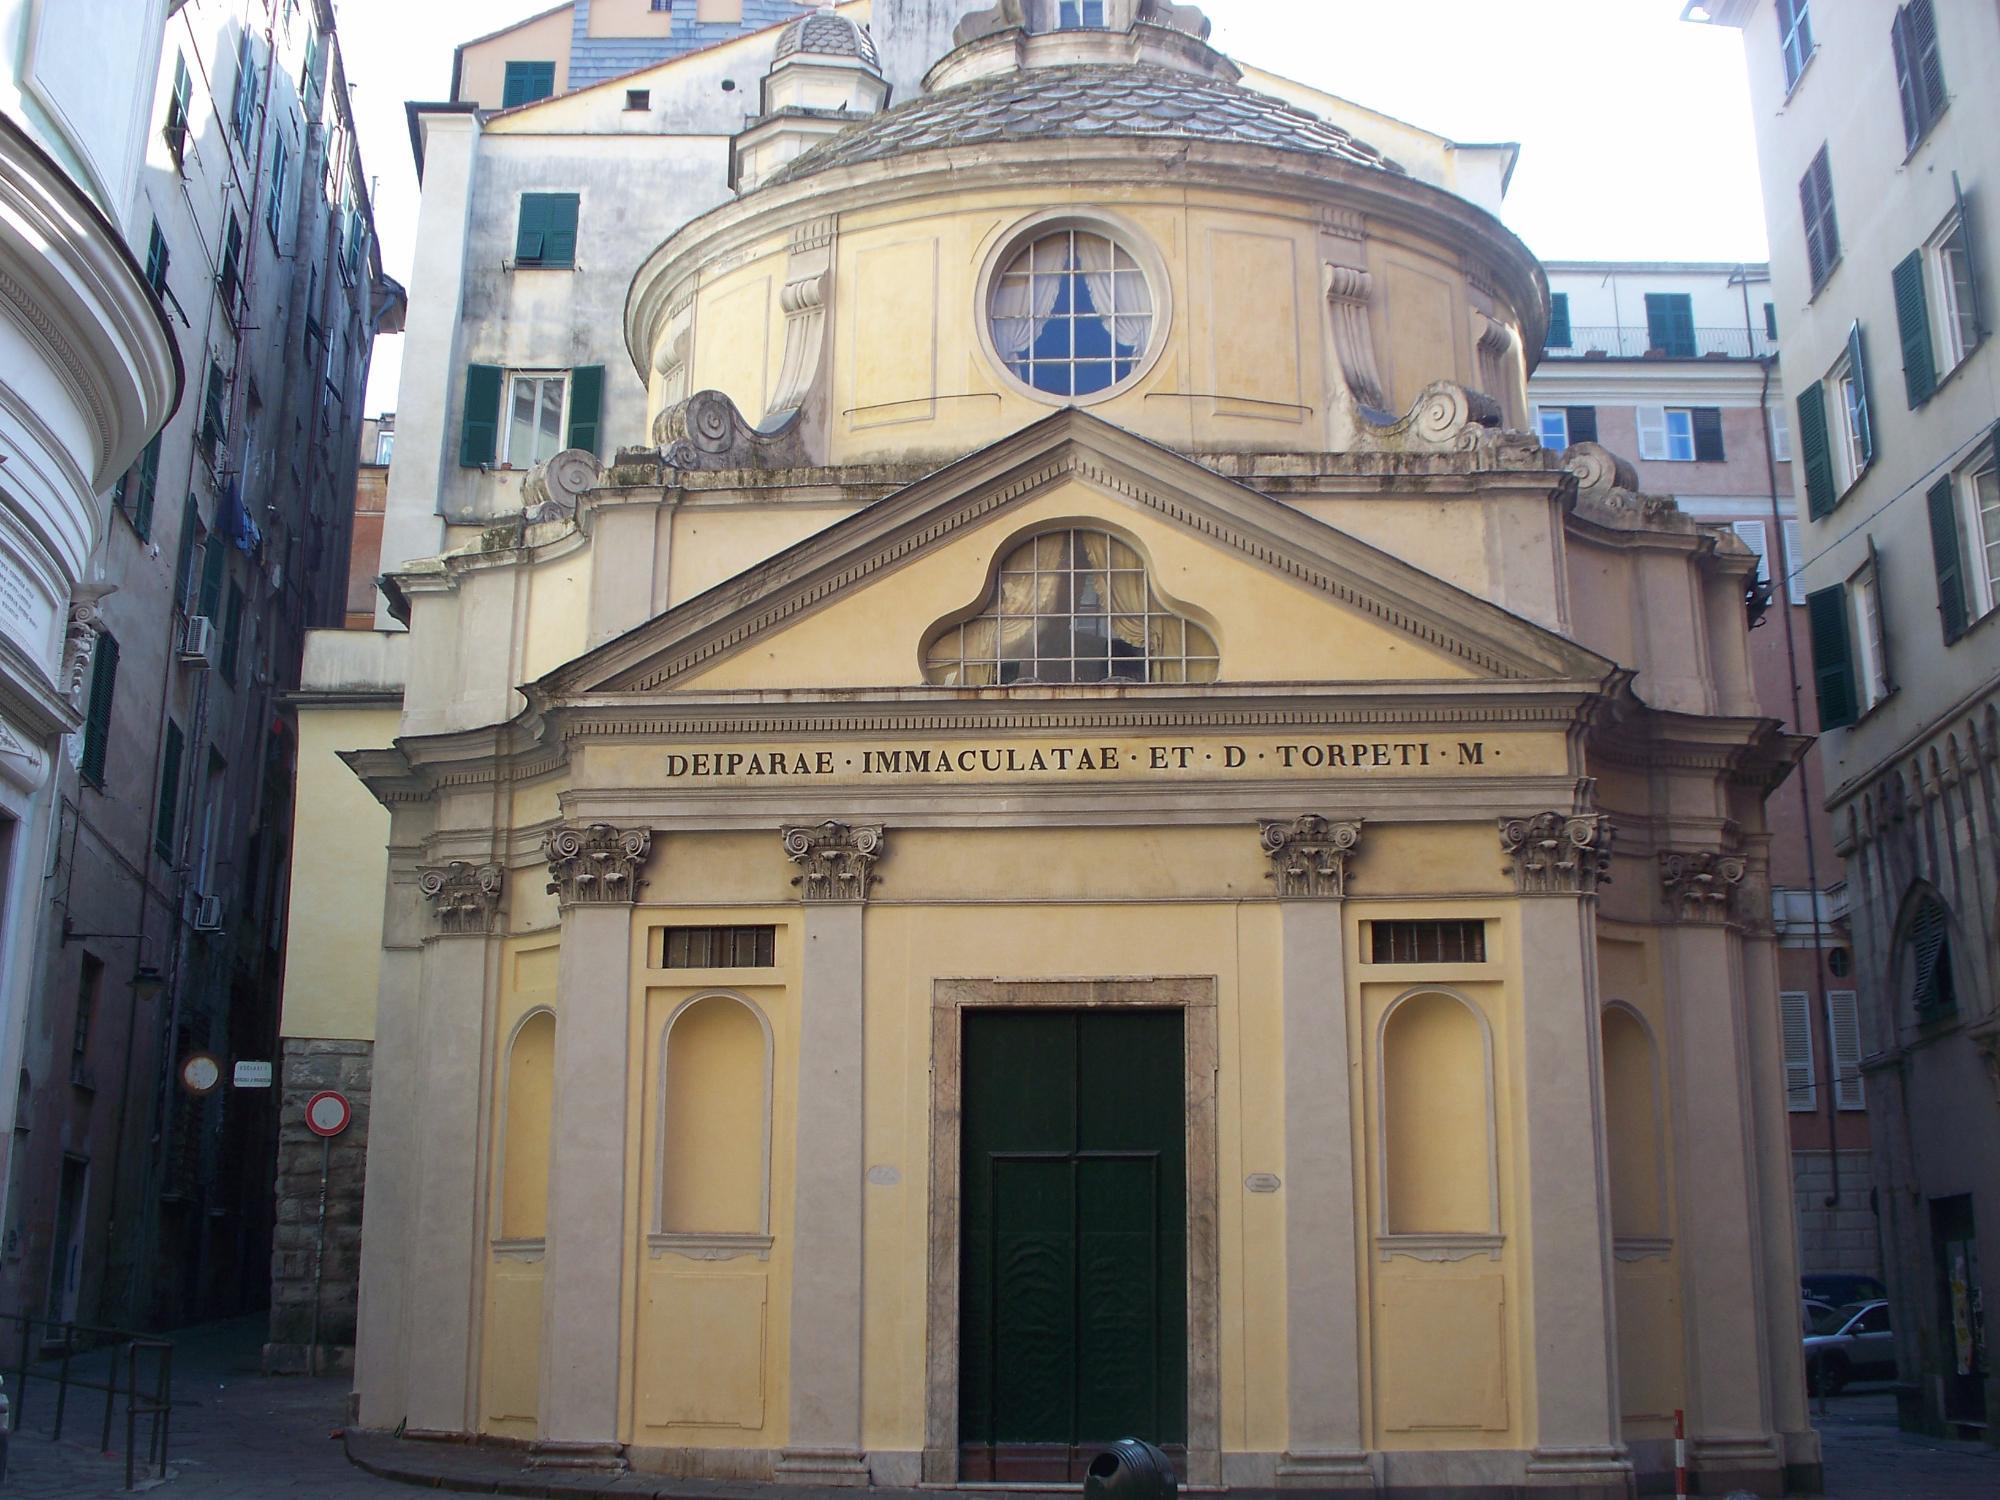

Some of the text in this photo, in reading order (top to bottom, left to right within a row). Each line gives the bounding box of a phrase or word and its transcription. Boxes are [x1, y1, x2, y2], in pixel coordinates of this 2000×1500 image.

[666, 742, 1484, 777] DEIPARAE IMMACULATAE ET D TORPETI M
